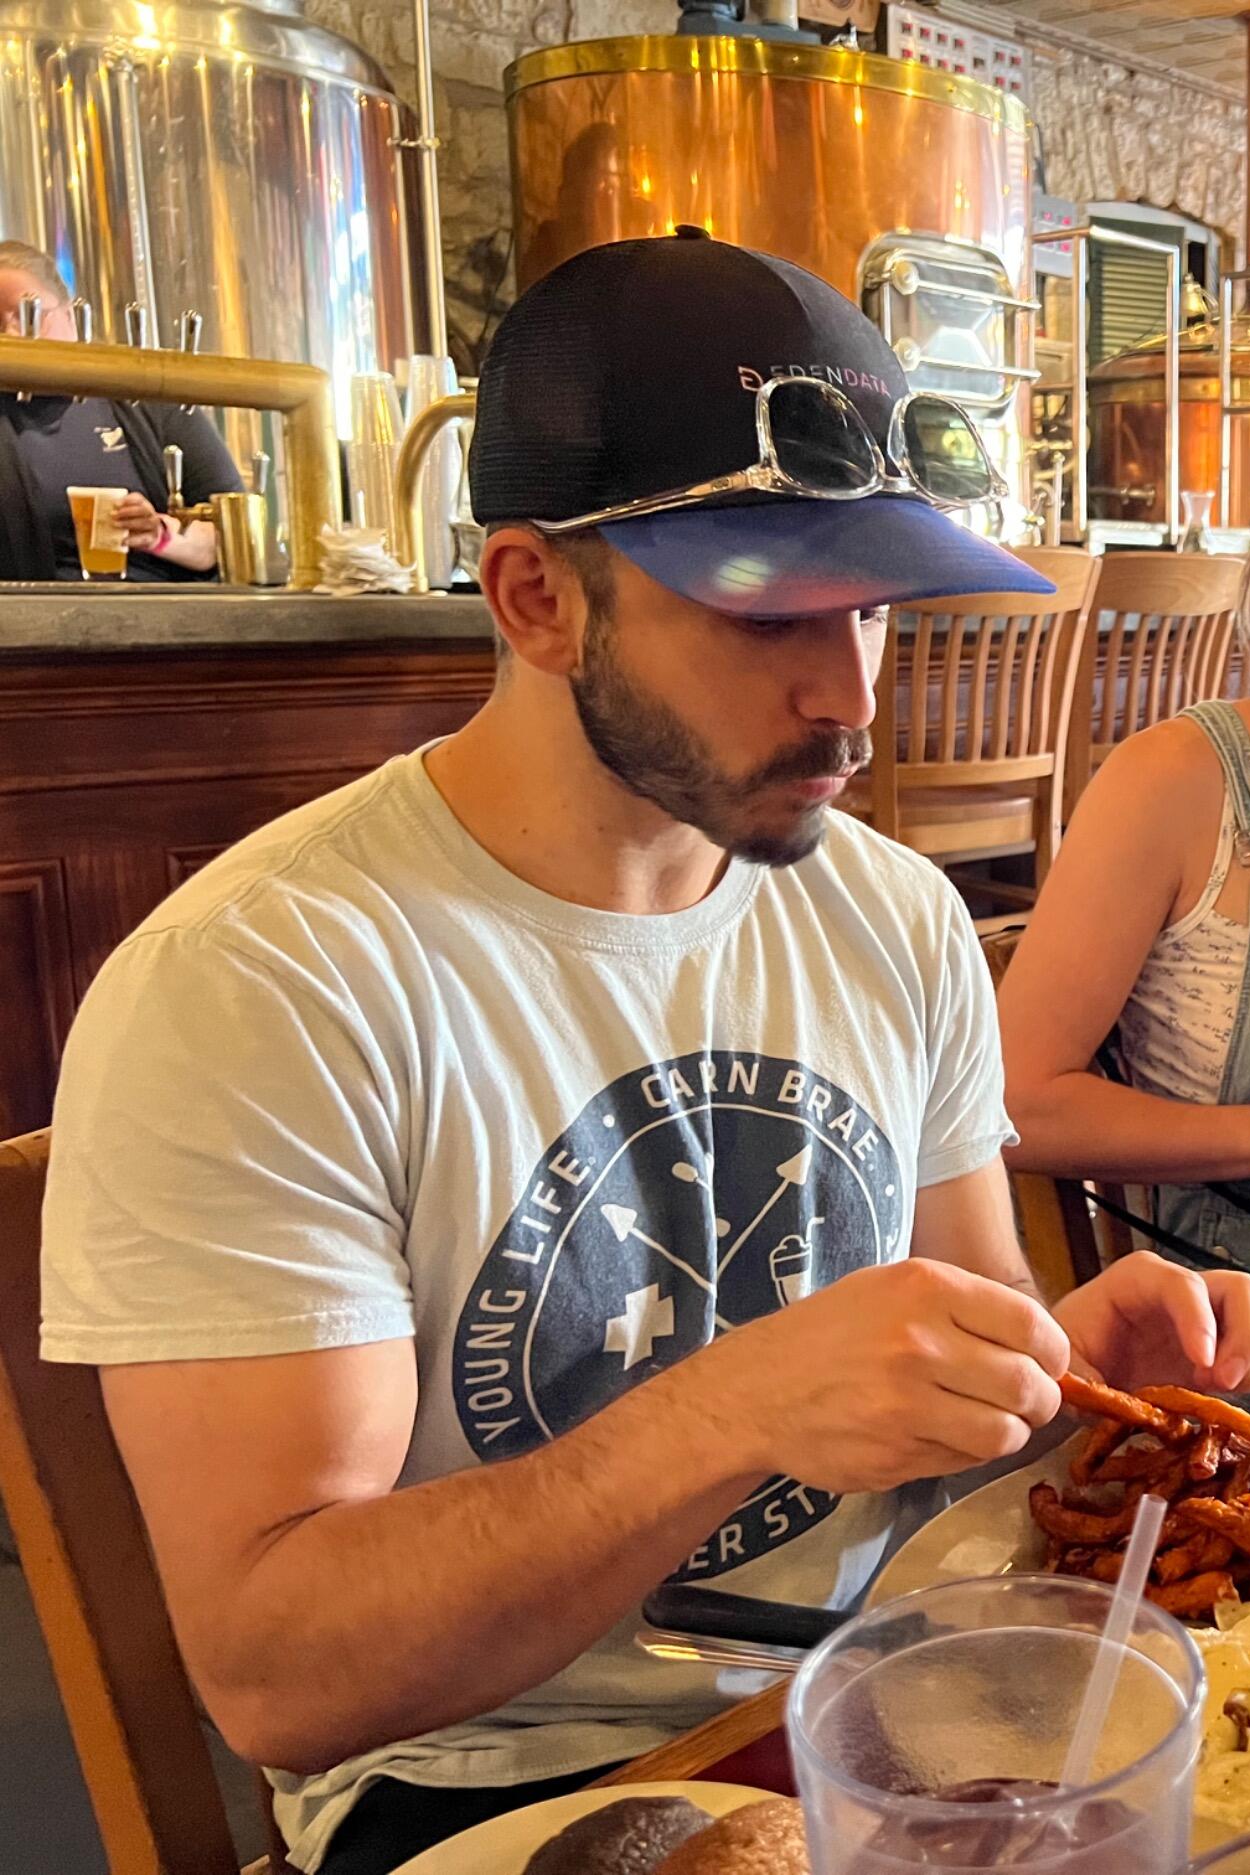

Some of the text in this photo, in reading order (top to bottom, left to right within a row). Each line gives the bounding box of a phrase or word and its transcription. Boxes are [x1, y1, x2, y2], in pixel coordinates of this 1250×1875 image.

[641, 1060, 879, 1160] CARN BRAE
[464, 1147, 591, 1444] YOUNG LIFE
